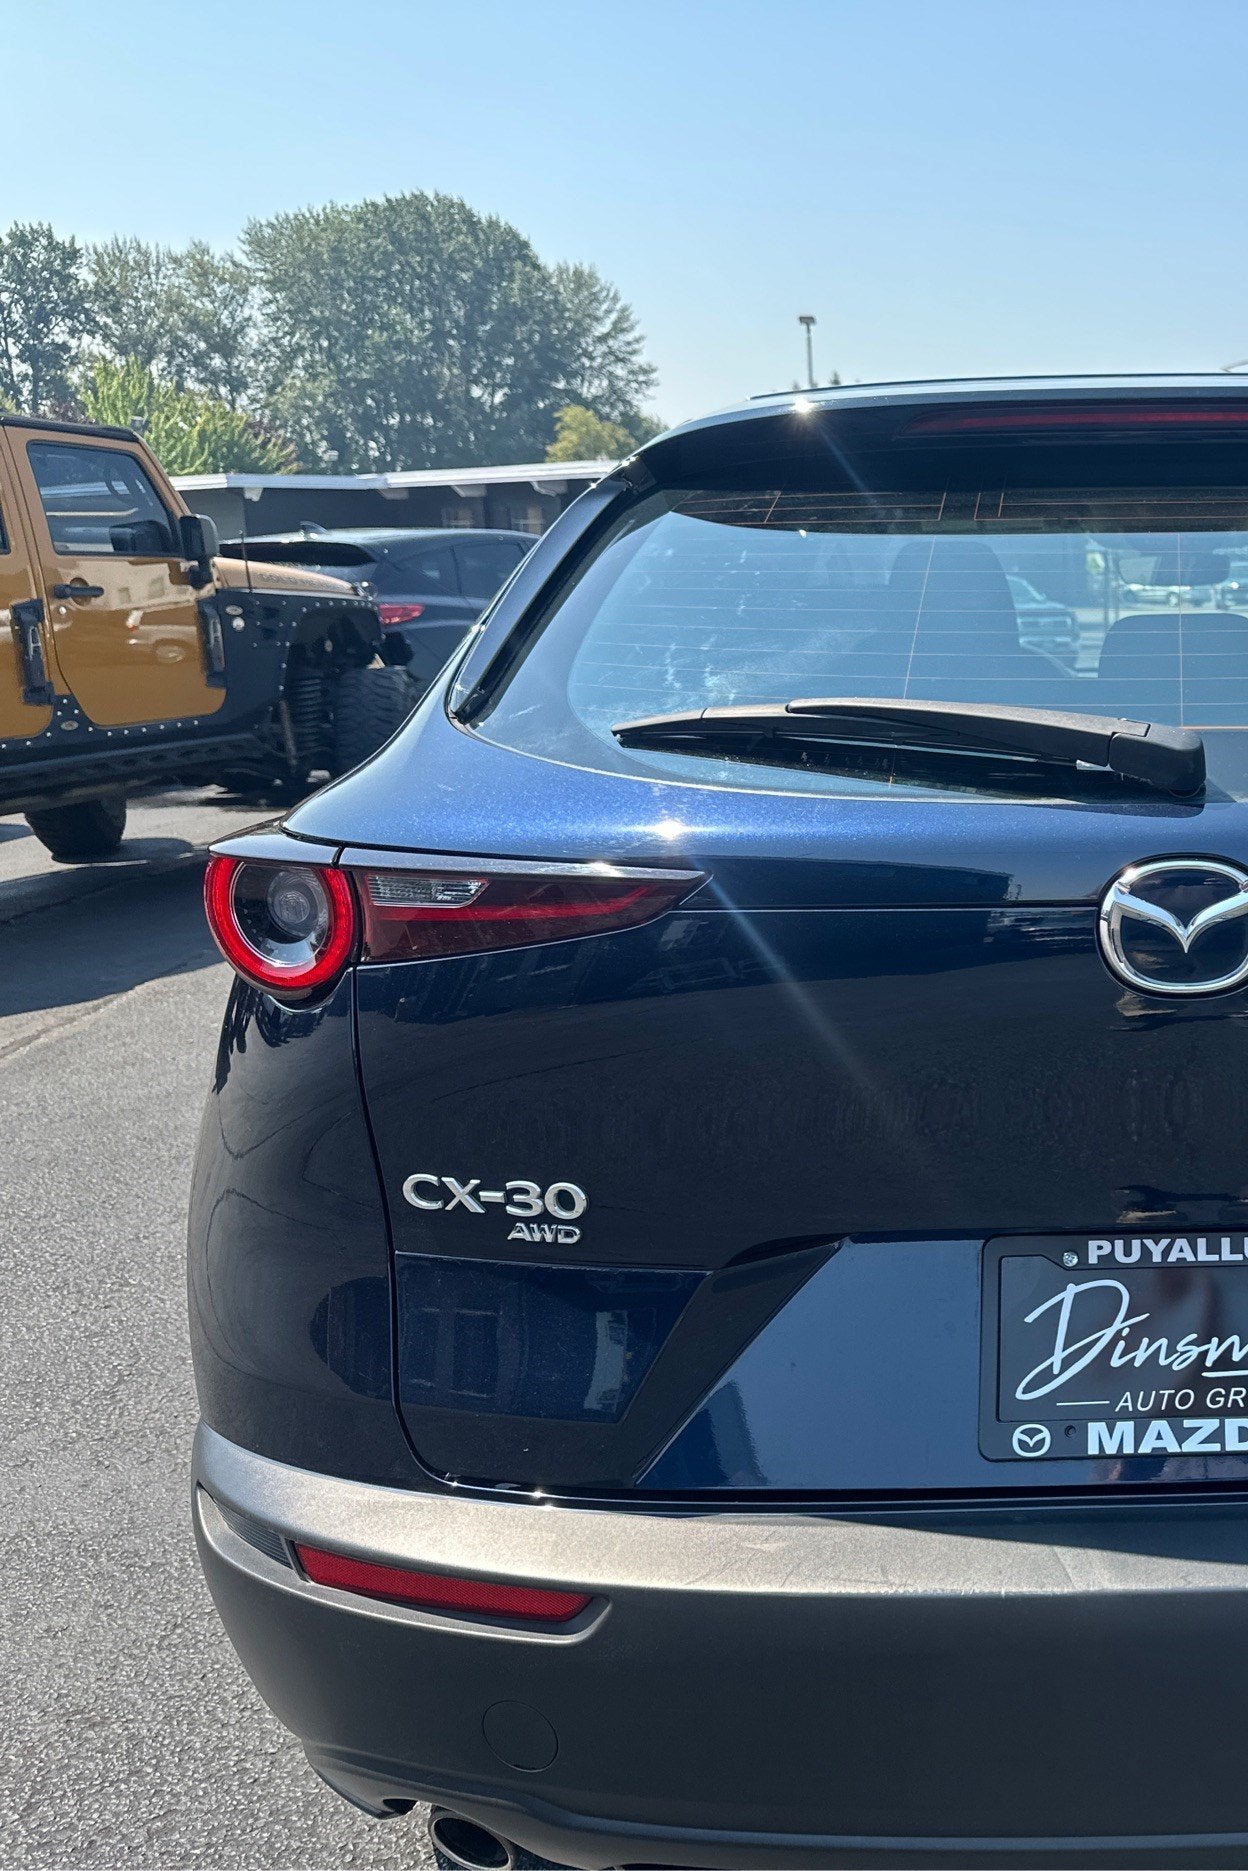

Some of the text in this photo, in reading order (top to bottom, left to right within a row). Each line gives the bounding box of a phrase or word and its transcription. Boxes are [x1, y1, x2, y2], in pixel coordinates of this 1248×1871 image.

[402, 1173, 588, 1220] CX-30
[507, 1222, 581, 1244] AWD
[1115, 1389, 1195, 1412] AUTO
